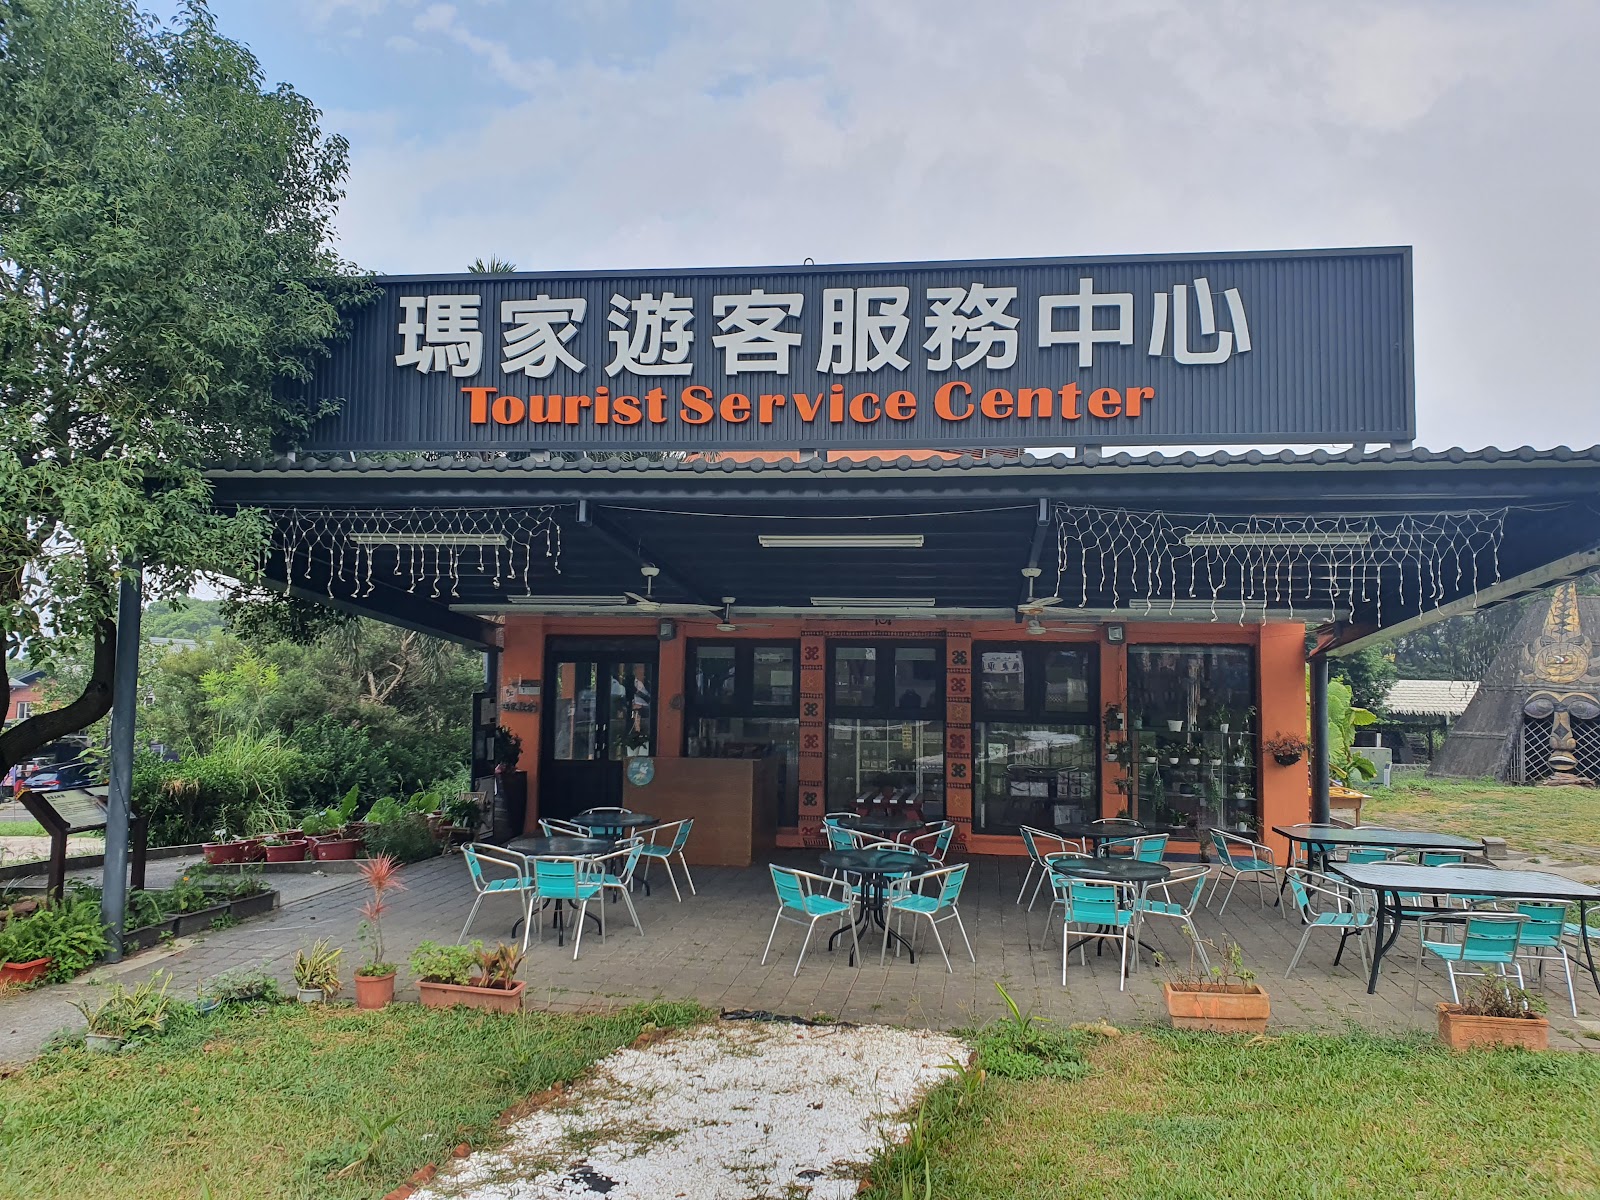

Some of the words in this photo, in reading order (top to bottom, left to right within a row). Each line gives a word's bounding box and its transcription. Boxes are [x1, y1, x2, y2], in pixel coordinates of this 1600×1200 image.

[395, 276, 1252, 379] 瑪家遊客服務中心
[460, 386, 668, 426] Tourist
[680, 383, 918, 426] Service
[933, 380, 1156, 421] Center
